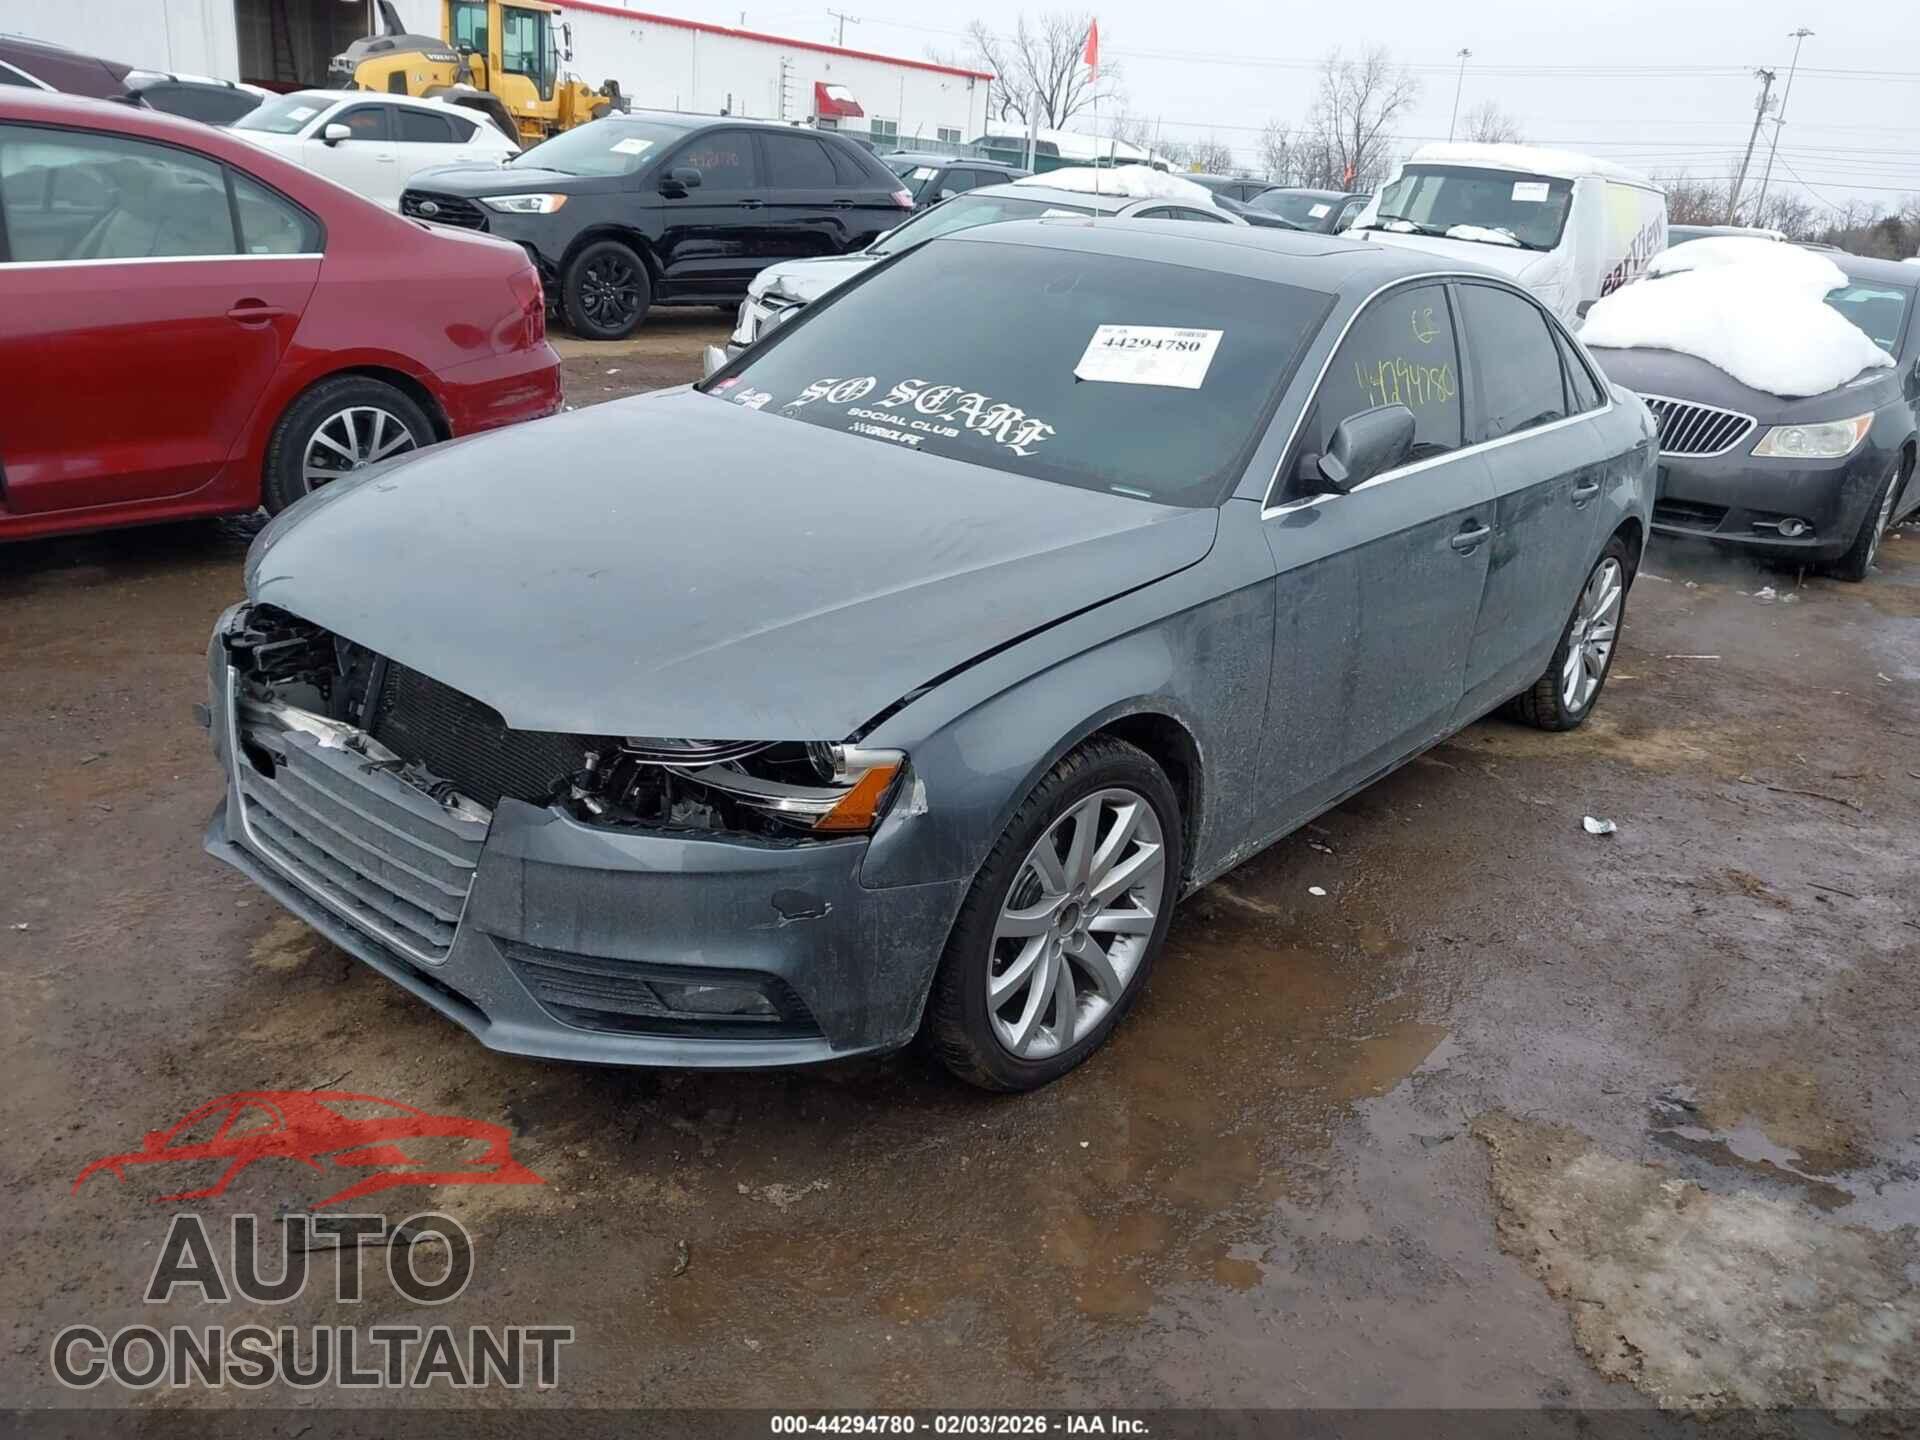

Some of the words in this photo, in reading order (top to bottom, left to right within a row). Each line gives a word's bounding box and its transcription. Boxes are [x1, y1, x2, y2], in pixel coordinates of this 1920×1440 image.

[1102, 337, 1202, 352] 44294780
[782, 376, 878, 408] SO
[847, 407, 907, 426] SOCIAL
[910, 420, 960, 438] CLUB
